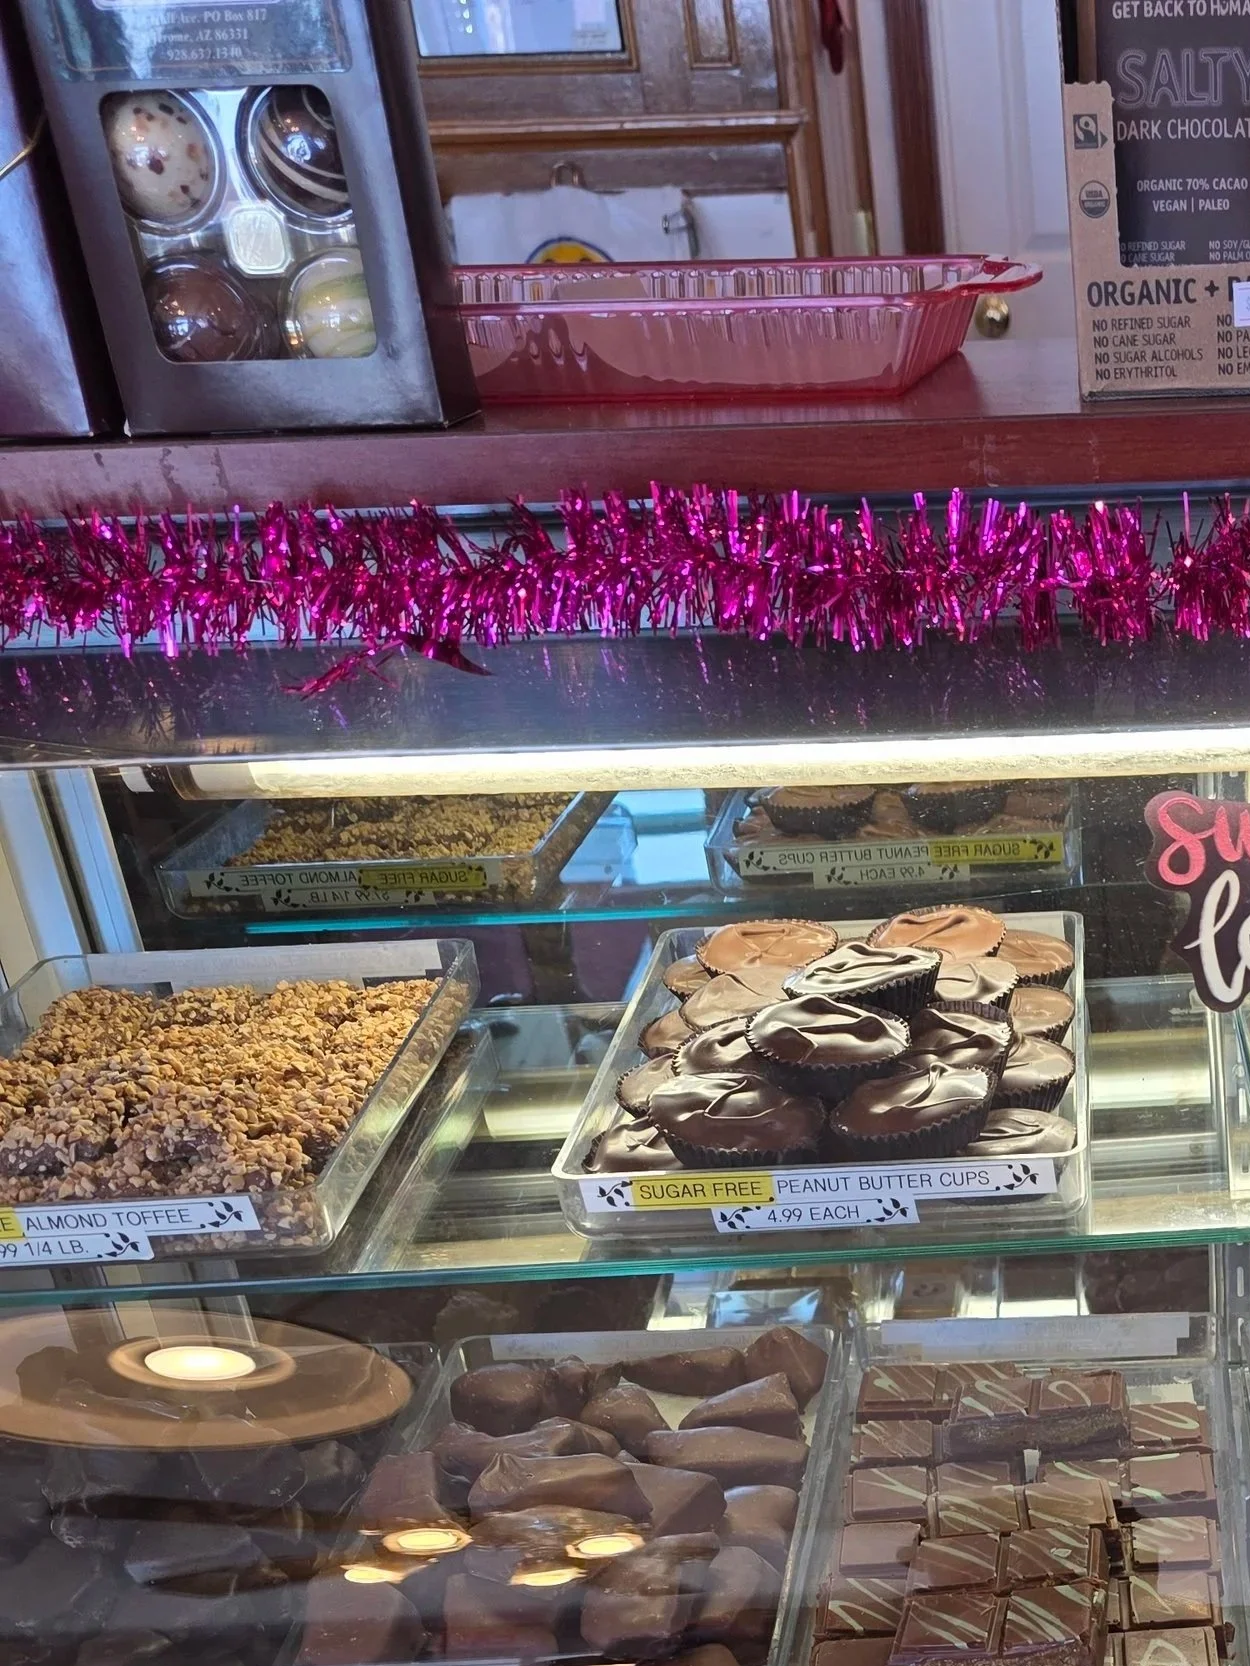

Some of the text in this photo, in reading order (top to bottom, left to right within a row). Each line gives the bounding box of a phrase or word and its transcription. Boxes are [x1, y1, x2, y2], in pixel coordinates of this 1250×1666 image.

[1112, 2, 1139, 19] GET
[1143, 0, 1181, 18] BACK
[1187, 0, 1207, 17] TO
[1116, 119, 1161, 141] DARK
[1137, 177, 1249, 192] ORGANIC 70% CACAO
[1153, 198, 1230, 212] VEGAN PALEO
[1087, 278, 1197, 307] ORGANIC
[1092, 315, 1191, 331] NO REFINED SUGAR
[1217, 346, 1233, 359] NO
[639, 1170, 990, 1200] SUGAR FREE PEANUT BUTTER CUPS
[26, 1212, 107, 1231] ALMOND
[112, 1208, 193, 1227] TOFFEE
[767, 1205, 859, 1224] 4.99 EACH
